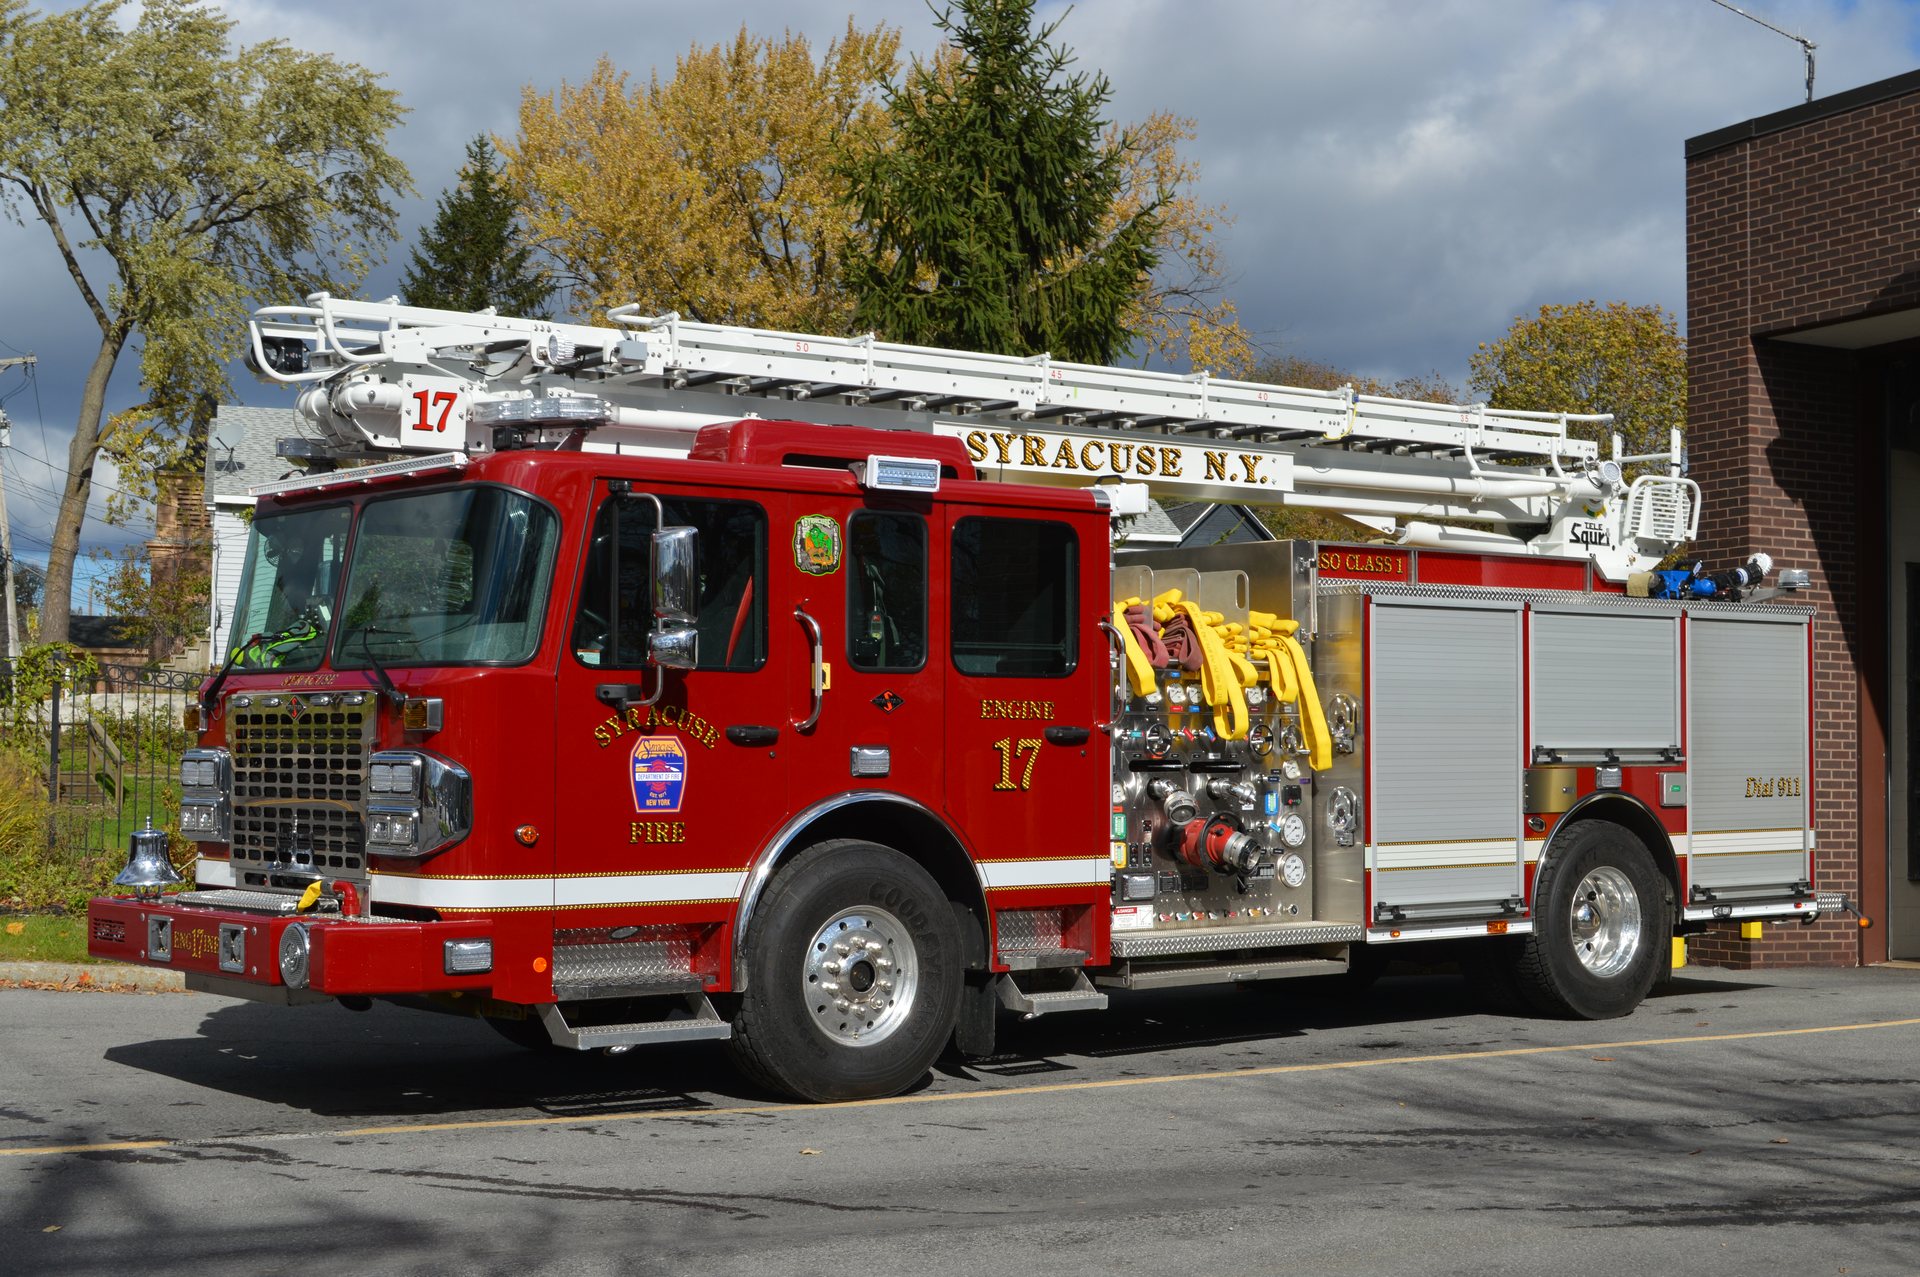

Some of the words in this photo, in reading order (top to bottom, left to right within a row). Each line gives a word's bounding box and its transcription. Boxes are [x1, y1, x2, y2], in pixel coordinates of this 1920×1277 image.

[796, 341, 809, 353] 50
[1051, 369, 1062, 380] 45
[1258, 392, 1268, 401] 40
[412, 388, 457, 433] 17
[966, 430, 1183, 477] SYRACUSE
[1204, 450, 1269, 484] N.Y.
[1584, 521, 1603, 531] TELE
[1345, 554, 1393, 574] CLASS
[1396, 557, 1403, 574] 1
[980, 699, 1055, 720] ENGINE
[594, 704, 720, 750] SYRACUSE
[993, 736, 1042, 792] 17
[1745, 777, 1774, 798] Dial
[1778, 777, 1801, 797] 911
[629, 822, 686, 844] FIRE
